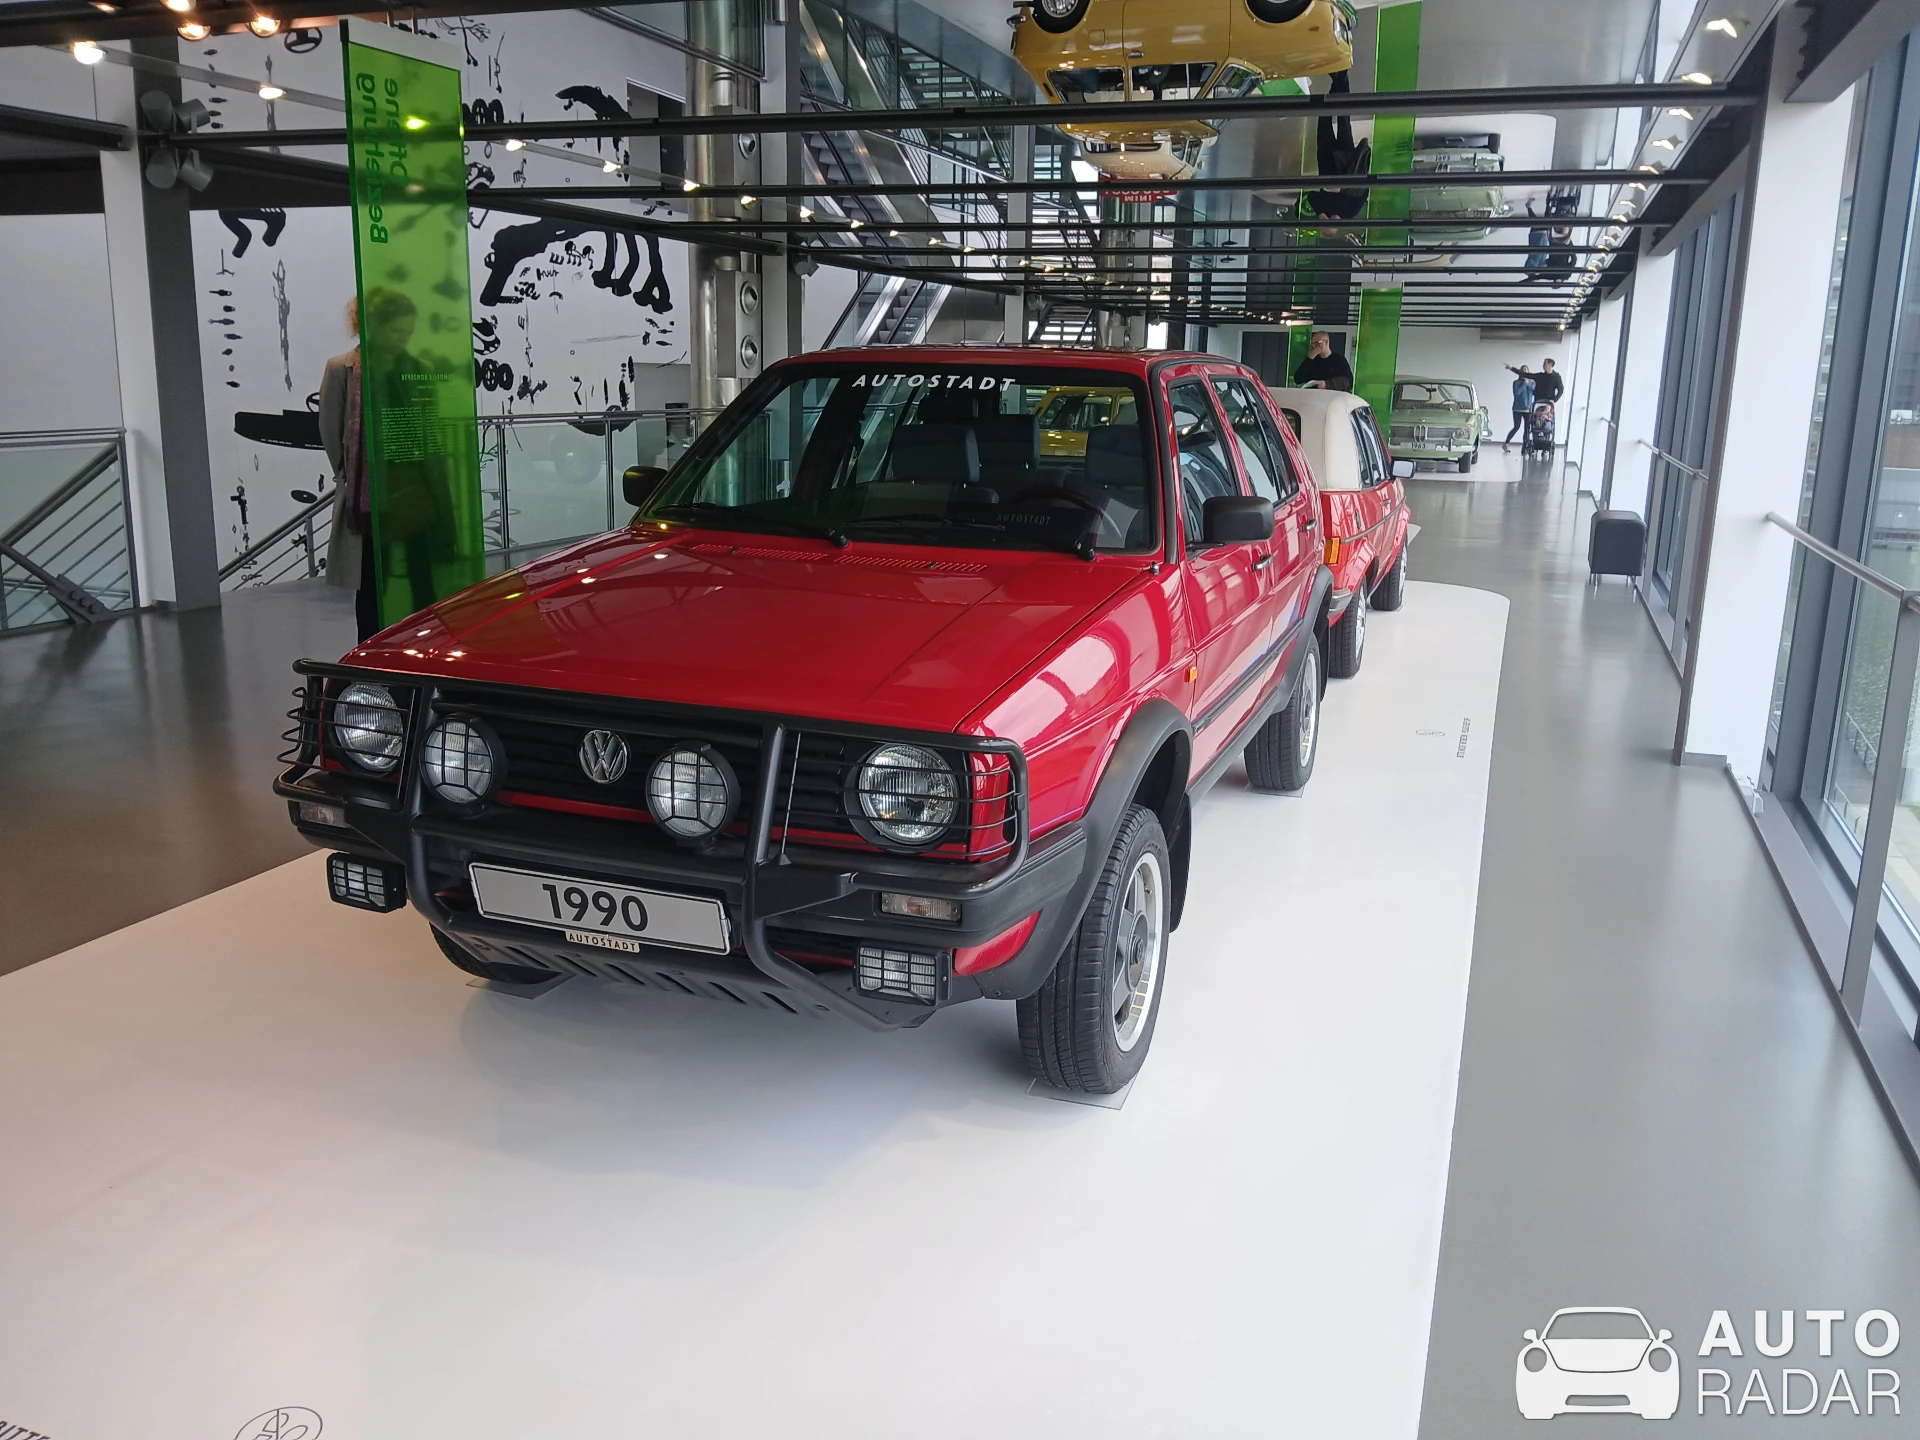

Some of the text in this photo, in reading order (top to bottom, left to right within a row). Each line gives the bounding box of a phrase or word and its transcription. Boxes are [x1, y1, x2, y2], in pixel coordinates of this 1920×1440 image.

[852, 374, 1016, 391] AUTOSTADT
[997, 513, 1051, 527] AUTOSTADT
[542, 883, 649, 932] 1990
[568, 932, 637, 951] AUTOSTADT
